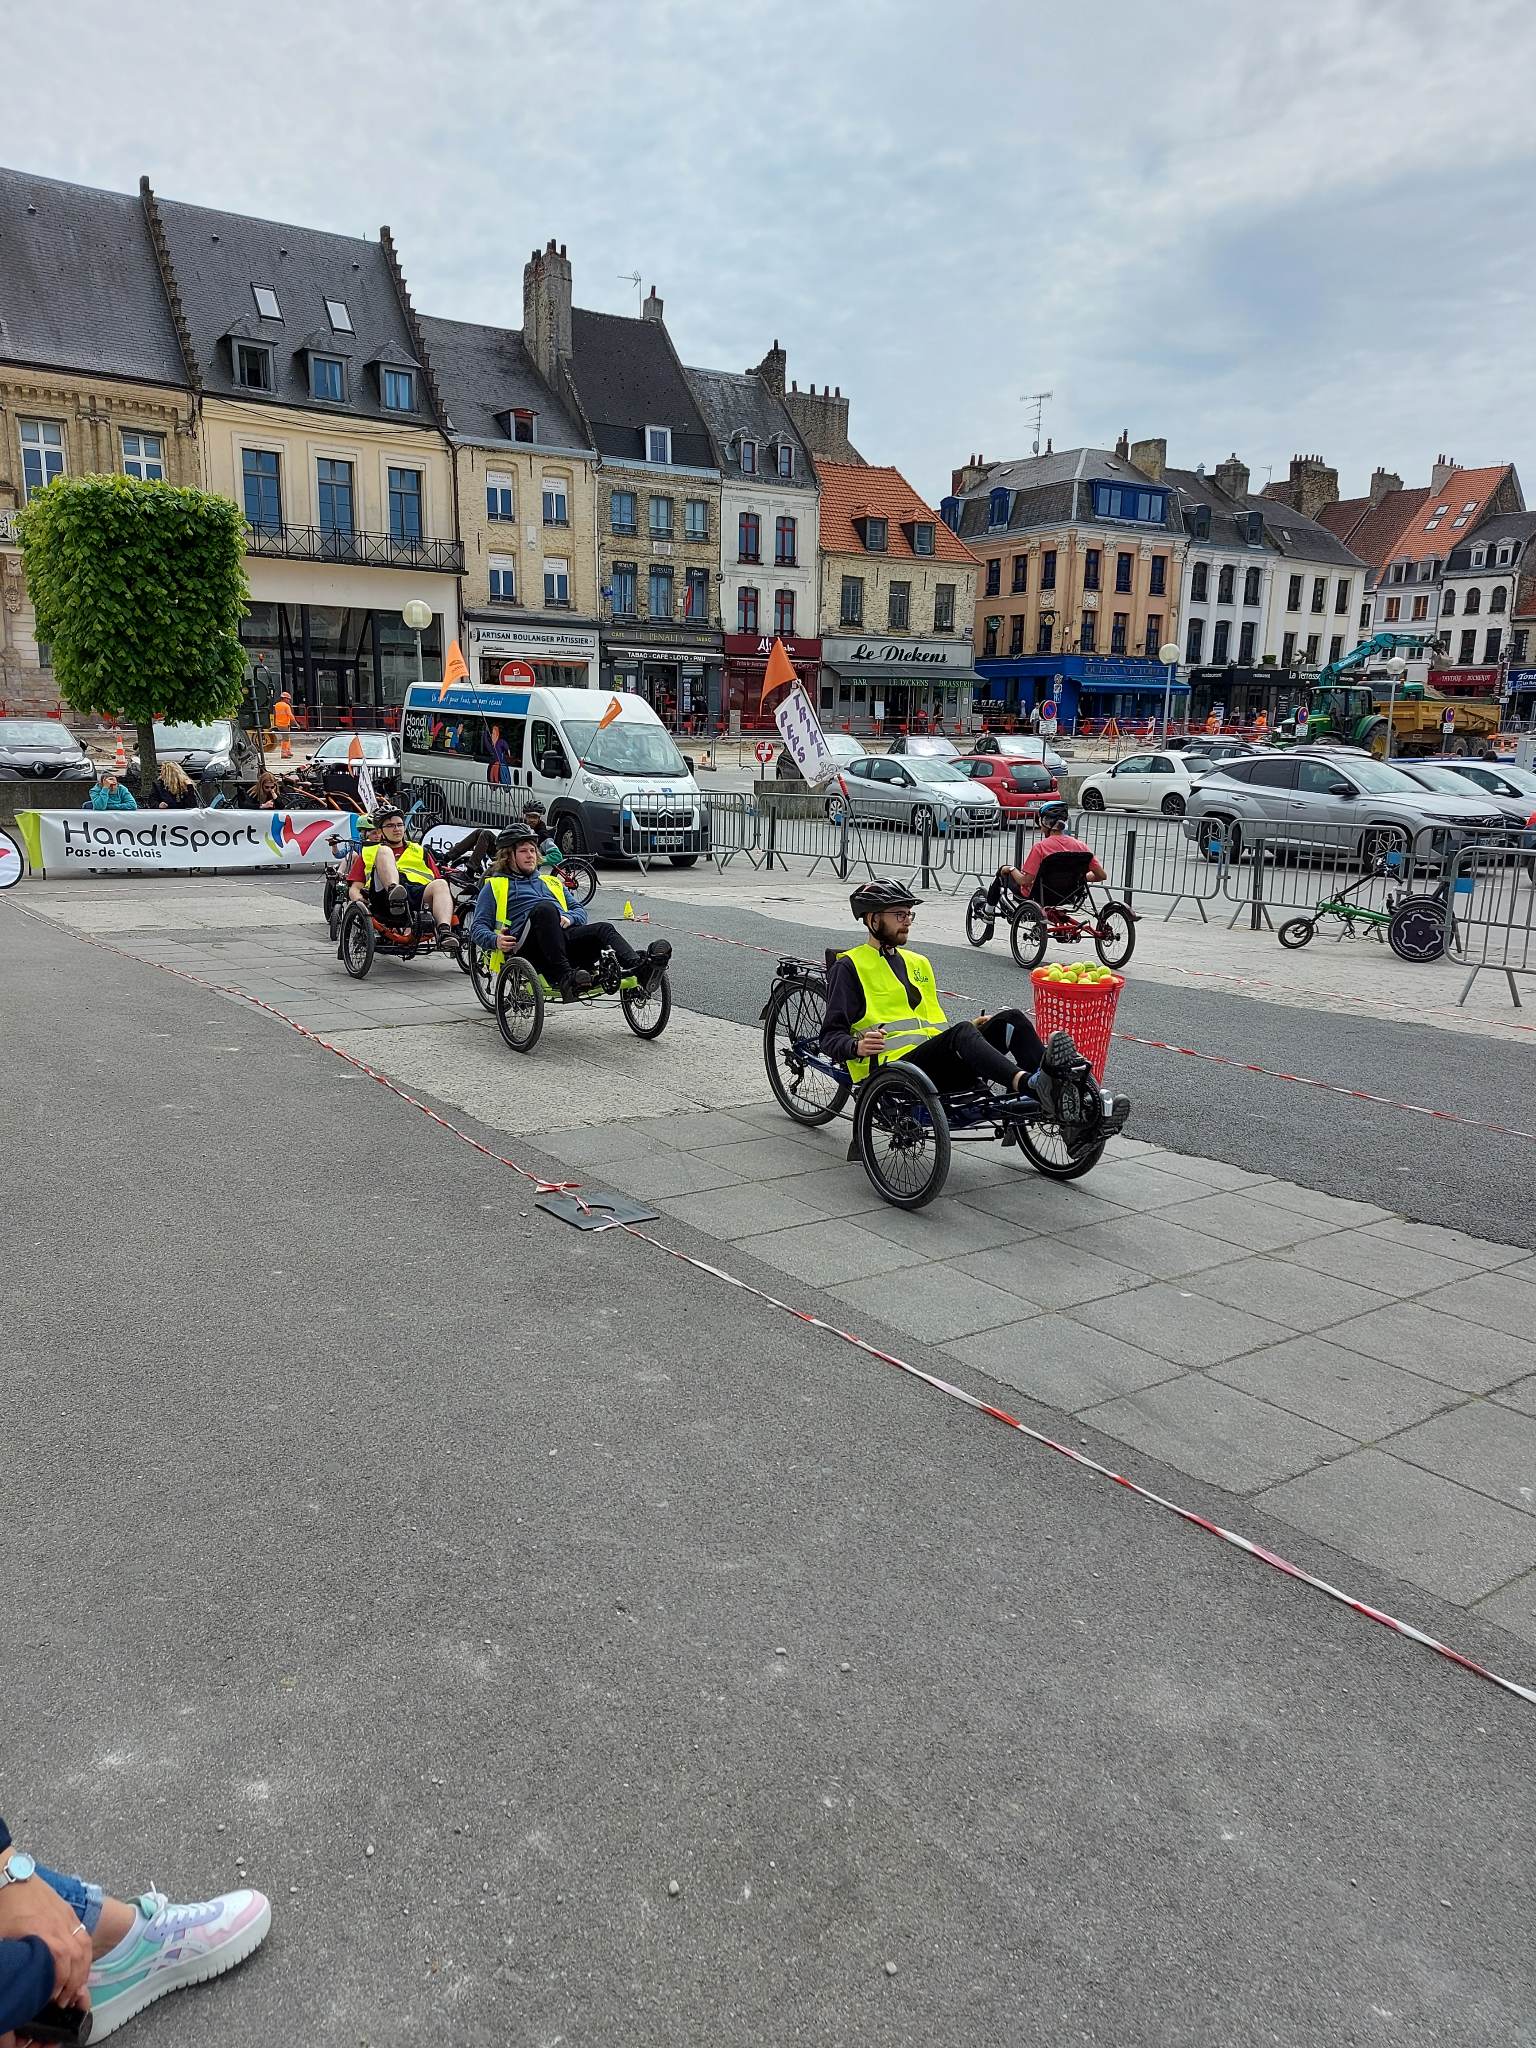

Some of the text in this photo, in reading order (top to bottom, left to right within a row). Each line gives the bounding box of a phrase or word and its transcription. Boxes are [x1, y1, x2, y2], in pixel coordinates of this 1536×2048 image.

[481, 630, 590, 645] ARTISAN BOULANGER PÂTISSIER
[649, 632, 685, 642] PENALTY
[628, 651, 648, 659] TABAC
[851, 643, 949, 663] Le Dickens
[1288, 670, 1297, 679] La
[852, 678, 868, 686] BAR
[900, 679, 929, 687] DICKENS
[939, 680, 974, 688] BRASSERIE
[405, 713, 428, 727] Handi
[793, 694, 824, 758] TRIKE
[406, 726, 426, 745] Sport
[780, 710, 806, 763] PEPS
[62, 819, 260, 853] HandiSport
[65, 845, 163, 859] Pas-de-Calais
